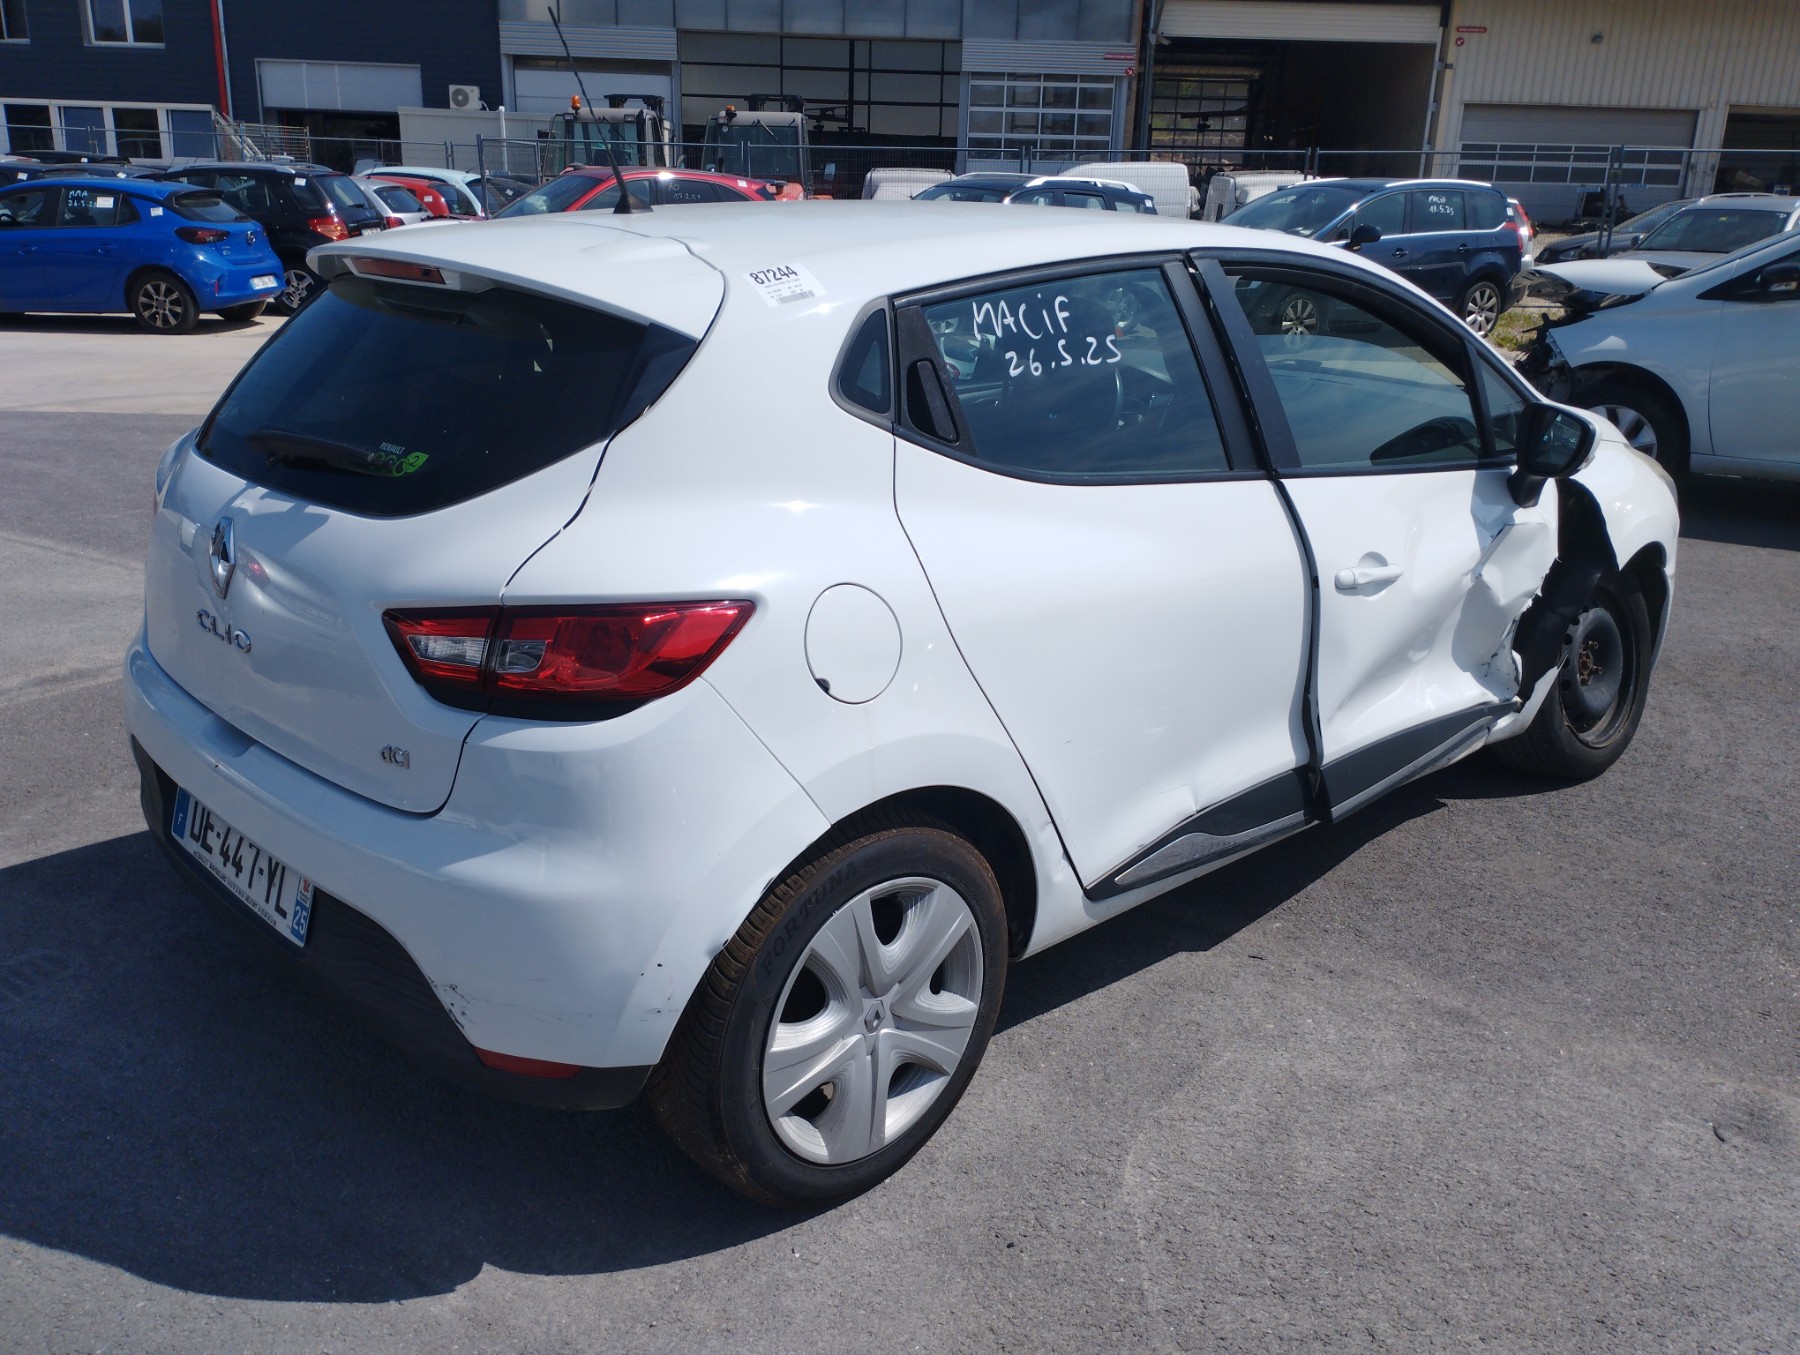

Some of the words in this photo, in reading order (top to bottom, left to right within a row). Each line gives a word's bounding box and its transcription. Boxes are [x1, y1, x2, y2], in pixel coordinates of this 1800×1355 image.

[749, 265, 798, 285] 87244
[1005, 334, 1122, 377] 26.5.25
[380, 441, 406, 455] RENAULT
[196, 608, 252, 654] CLIO
[177, 812, 184, 825] F
[292, 905, 308, 935] 25
[761, 860, 858, 978] FORTUNA
